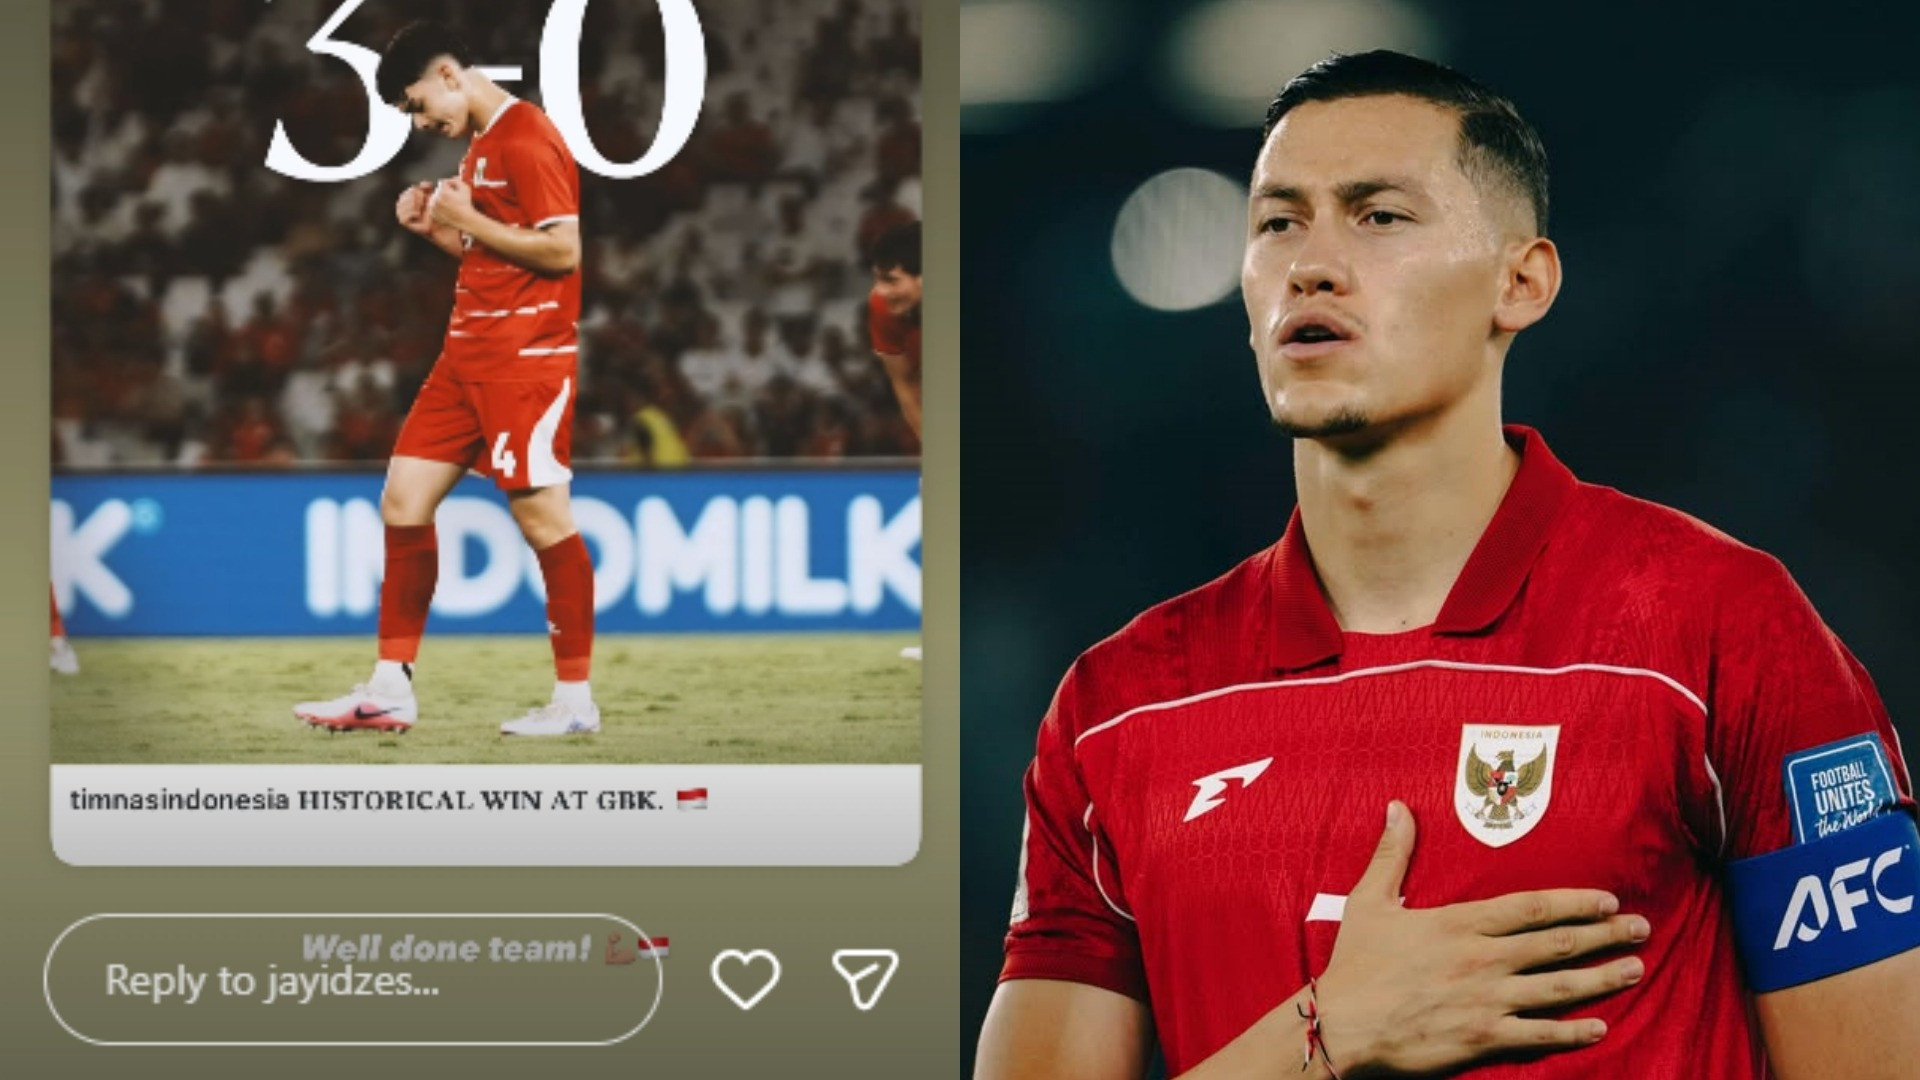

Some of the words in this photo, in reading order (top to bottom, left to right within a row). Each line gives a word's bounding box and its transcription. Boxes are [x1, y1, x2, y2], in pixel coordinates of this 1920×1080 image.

[491, 431, 516, 478] 4
[1480, 729, 1543, 739] INDONESIA
[1811, 762, 1867, 791] FOOTBALL
[1814, 779, 1875, 815] UNITES
[1814, 815, 1841, 838] the
[1773, 846, 1914, 950] AFC
